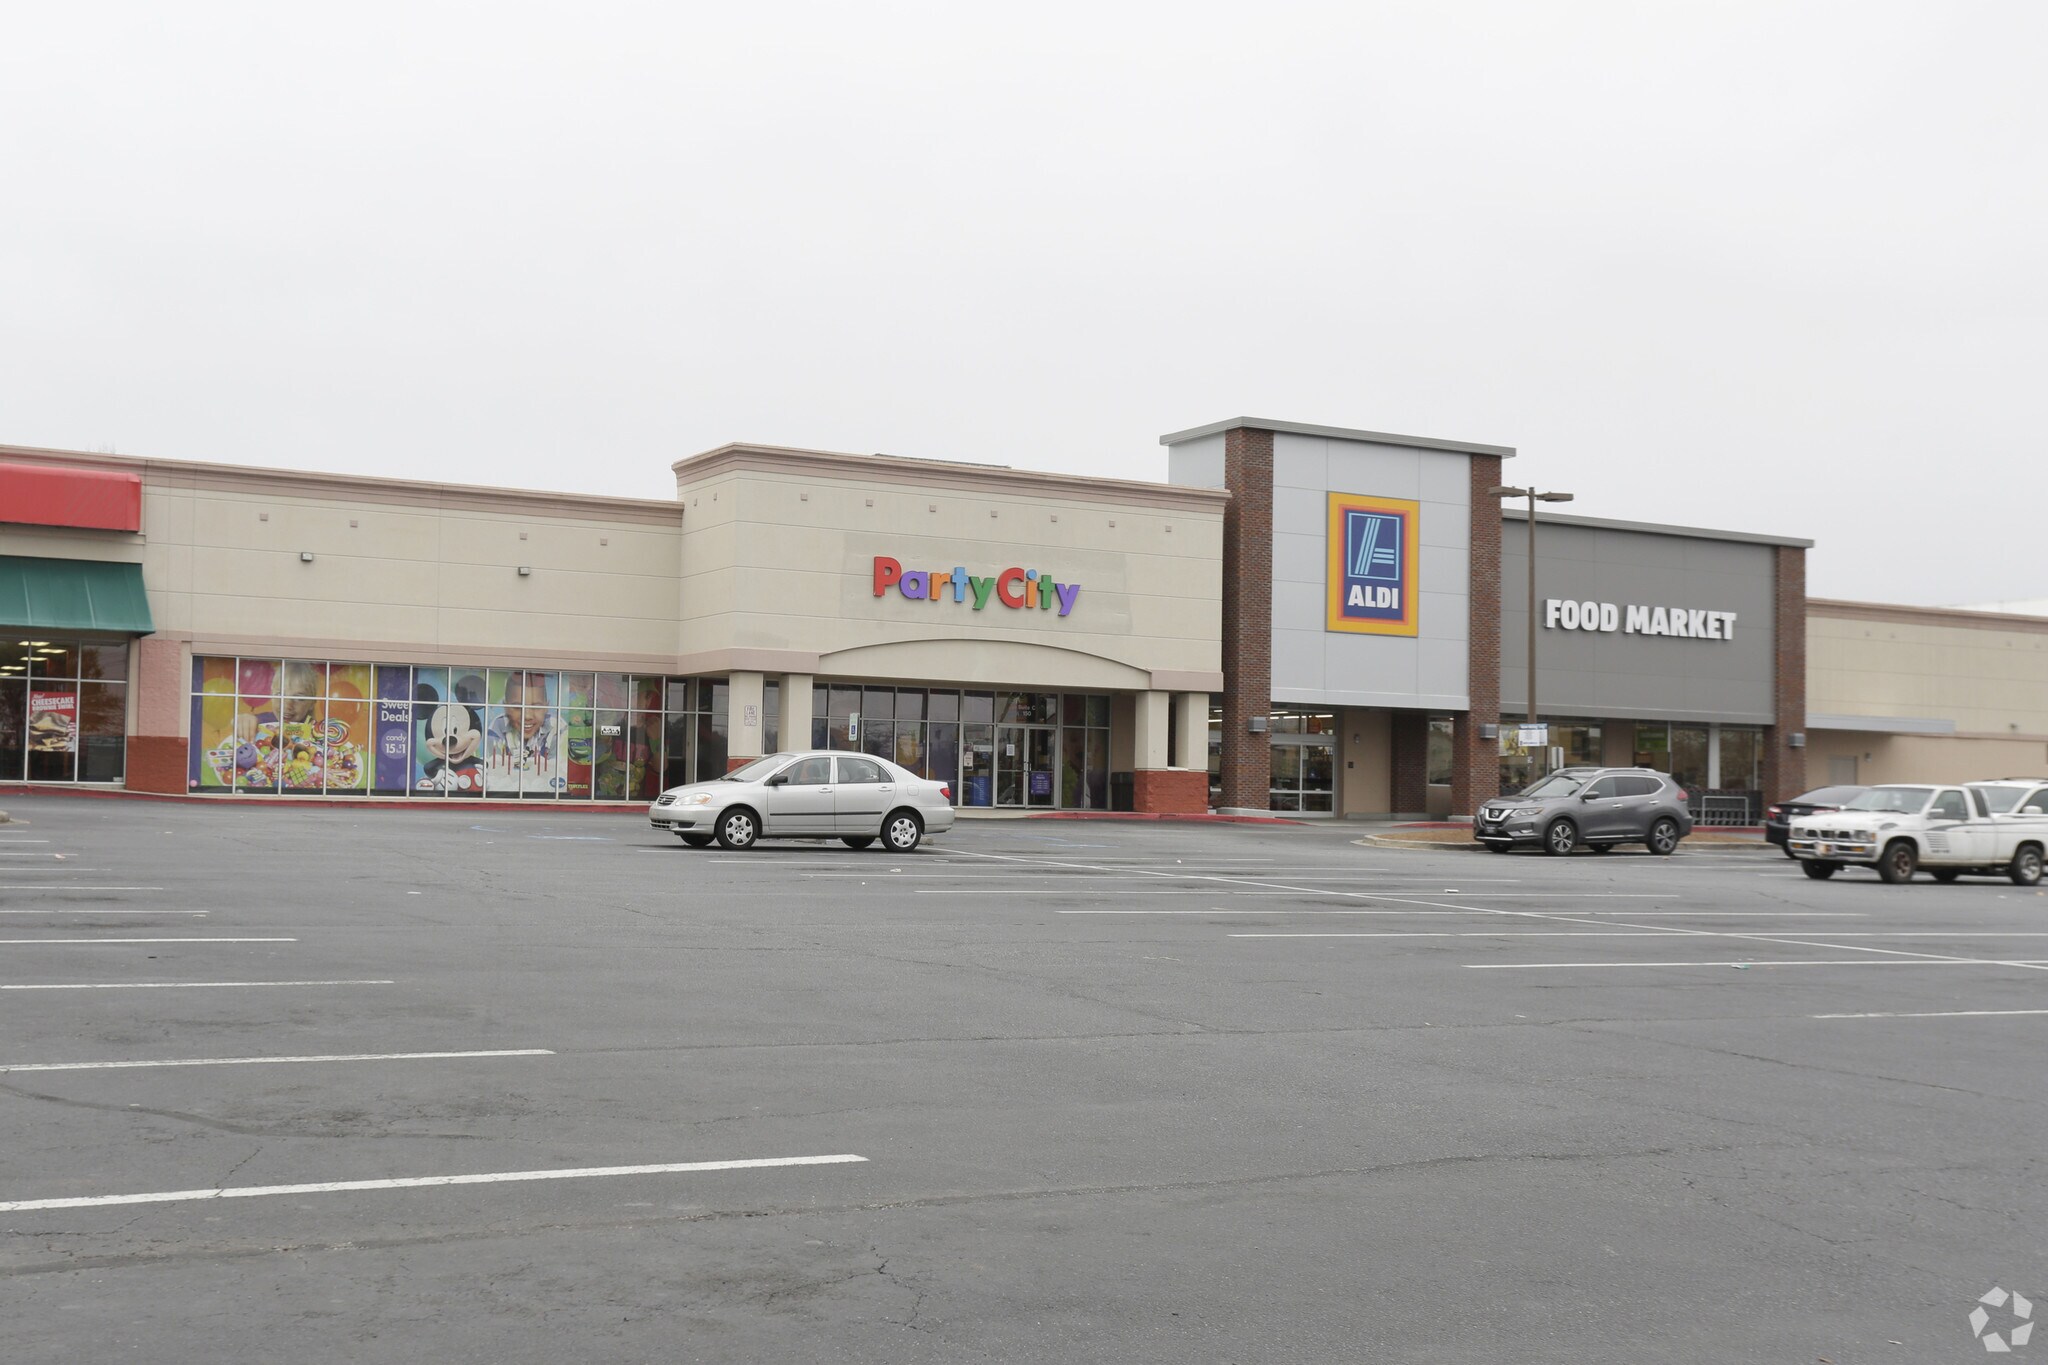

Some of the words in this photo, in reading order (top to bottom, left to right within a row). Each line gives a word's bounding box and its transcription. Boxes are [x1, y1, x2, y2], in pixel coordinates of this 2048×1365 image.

[1347, 584, 1399, 609] ALDI
[1545, 599, 1619, 631] FOOD
[1625, 604, 1736, 640] MARKET
[31, 697, 74, 705] CHEESECAKE
[386, 733, 407, 743] candy
[385, 743, 396, 754] 15
